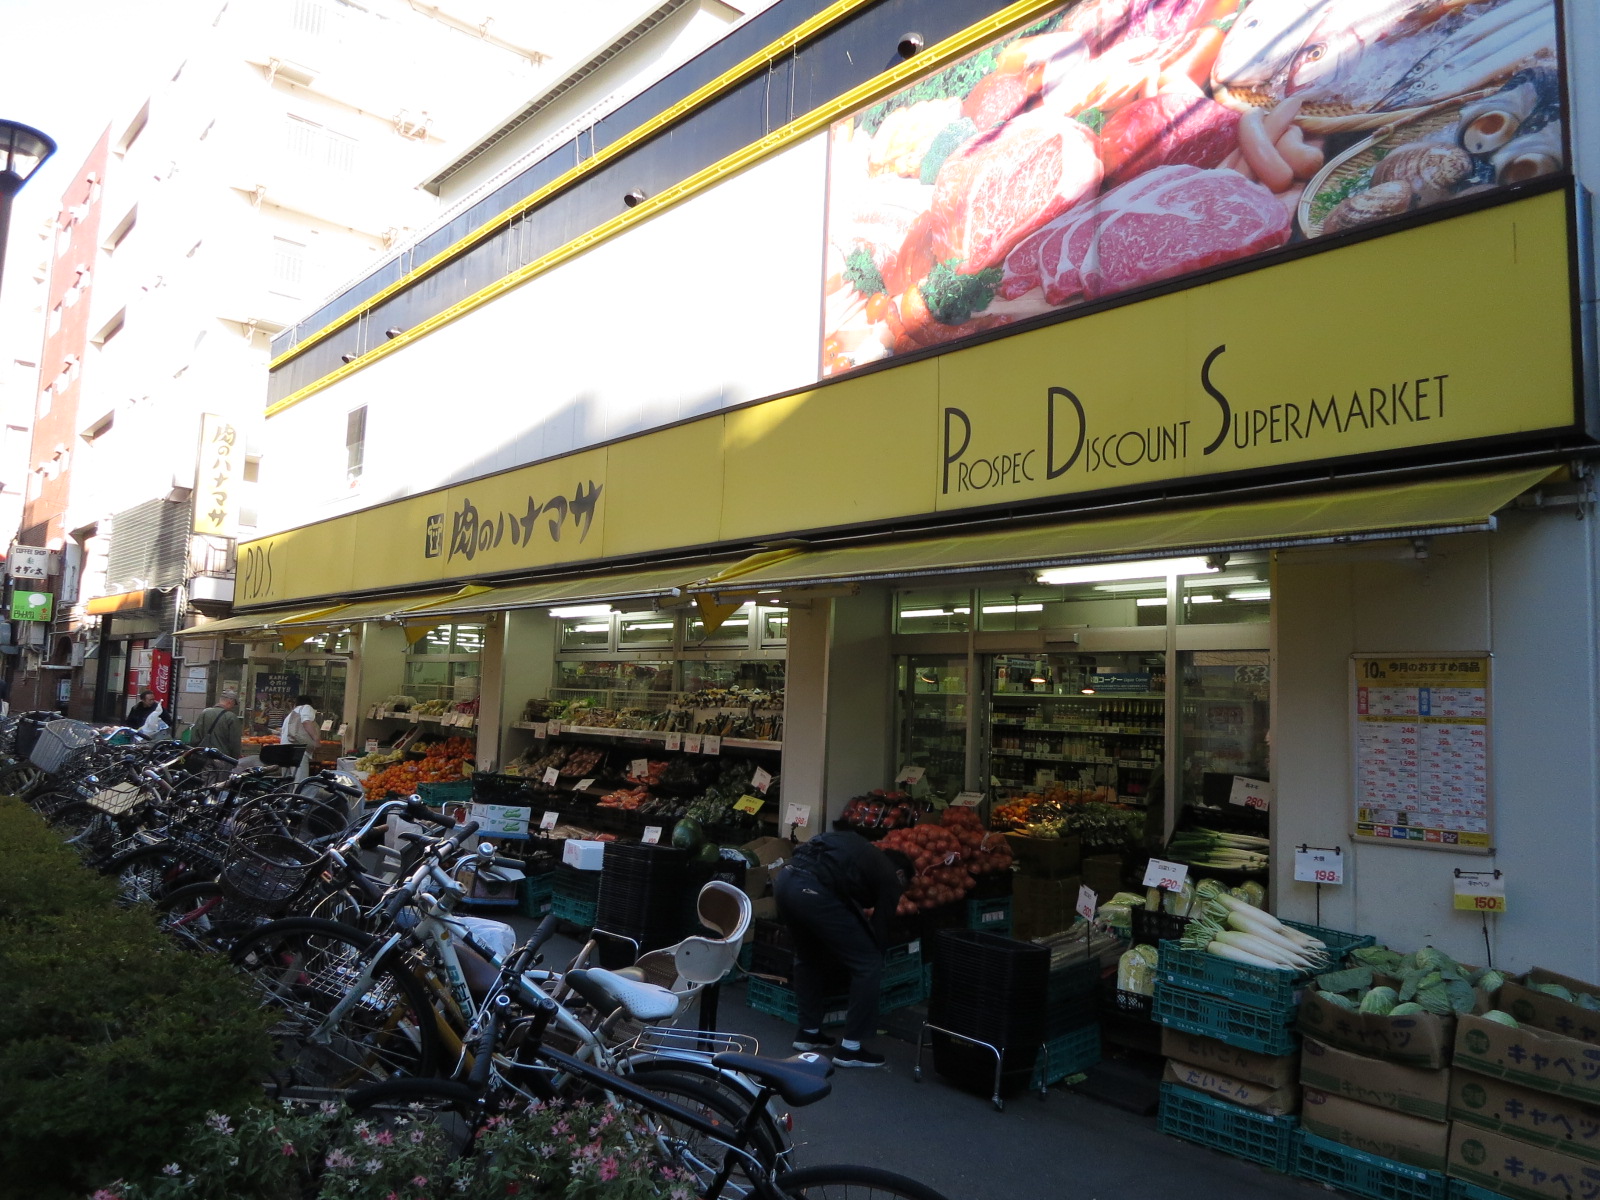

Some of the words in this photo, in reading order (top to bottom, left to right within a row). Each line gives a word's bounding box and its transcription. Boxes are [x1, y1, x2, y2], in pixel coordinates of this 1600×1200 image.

[942, 407, 1035, 494] PROSPEC
[1047, 387, 1191, 480] DISCOUNT
[1201, 344, 1449, 455] SUPERMARKET
[208, 423, 236, 528] 肉のハナマサ
[447, 479, 603, 565] 肉のハナマサ
[1389, 661, 1480, 673] 今月のおすすめ商品
[1186, 1070, 1249, 1099] だいこん
[1508, 1043, 1600, 1081] キャベツ
[1504, 1155, 1600, 1200] キャベツ
